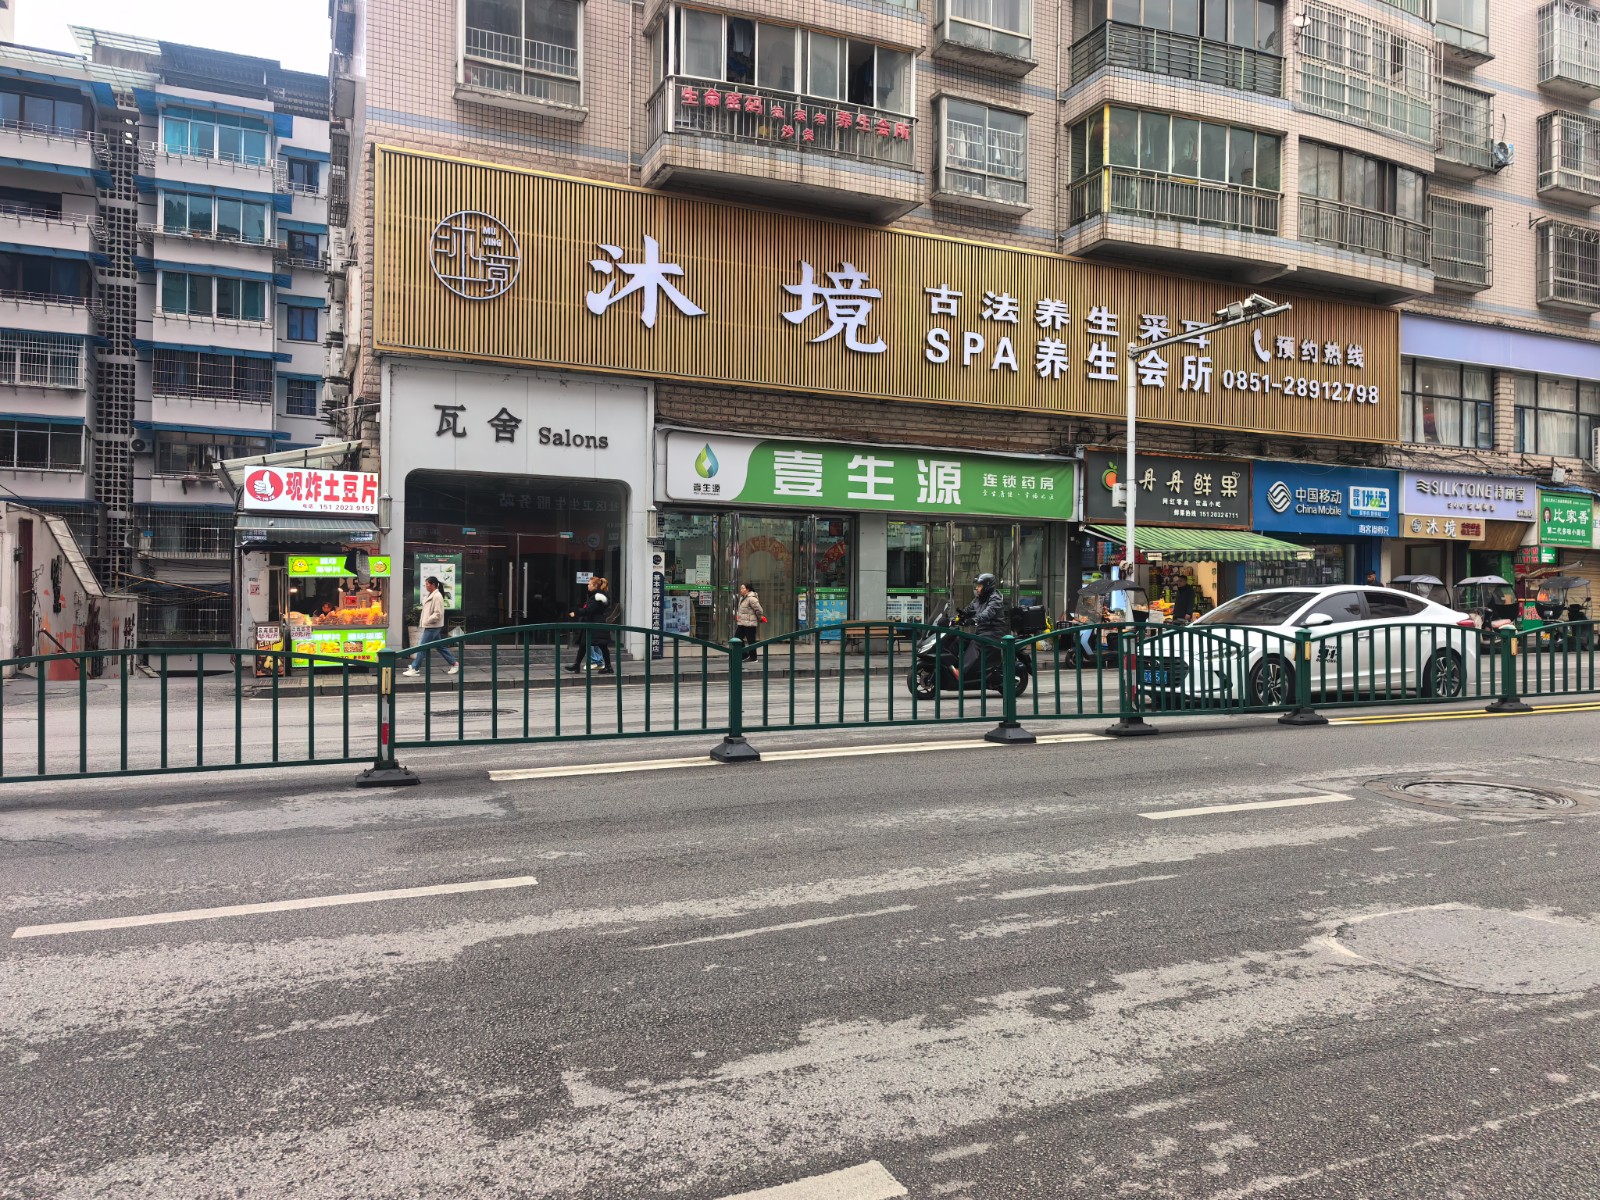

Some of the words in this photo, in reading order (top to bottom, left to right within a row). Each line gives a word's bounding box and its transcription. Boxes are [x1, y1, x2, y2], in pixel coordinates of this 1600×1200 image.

[681, 86, 763, 114] 生命密码
[835, 111, 911, 140] 养生会所
[482, 226, 497, 236] MU
[483, 238, 502, 247] JING
[586, 234, 888, 354] 沐境
[925, 283, 1212, 350] 古法养生采耳
[925, 327, 1019, 371] SPA
[1036, 336, 1213, 393] 养生会所
[1275, 335, 1365, 369] 预约热线
[1223, 369, 1380, 404] 0851-28912798
[433, 404, 523, 444] 瓦舍
[538, 425, 609, 450] Salons
[285, 471, 377, 505] 现炸土豆片
[773, 450, 961, 505] 壹生源
[983, 473, 1054, 490] 连锁药房
[1138, 467, 1240, 498] 丹丹鲜果
[1431, 480, 1493, 499] SILKTONE
[1295, 487, 1342, 504] 中国移动
[1295, 504, 1317, 514] China
[1318, 505, 1342, 516] Mobile
[1426, 517, 1457, 538] 沐境
[1553, 508, 1589, 525] 比家香
